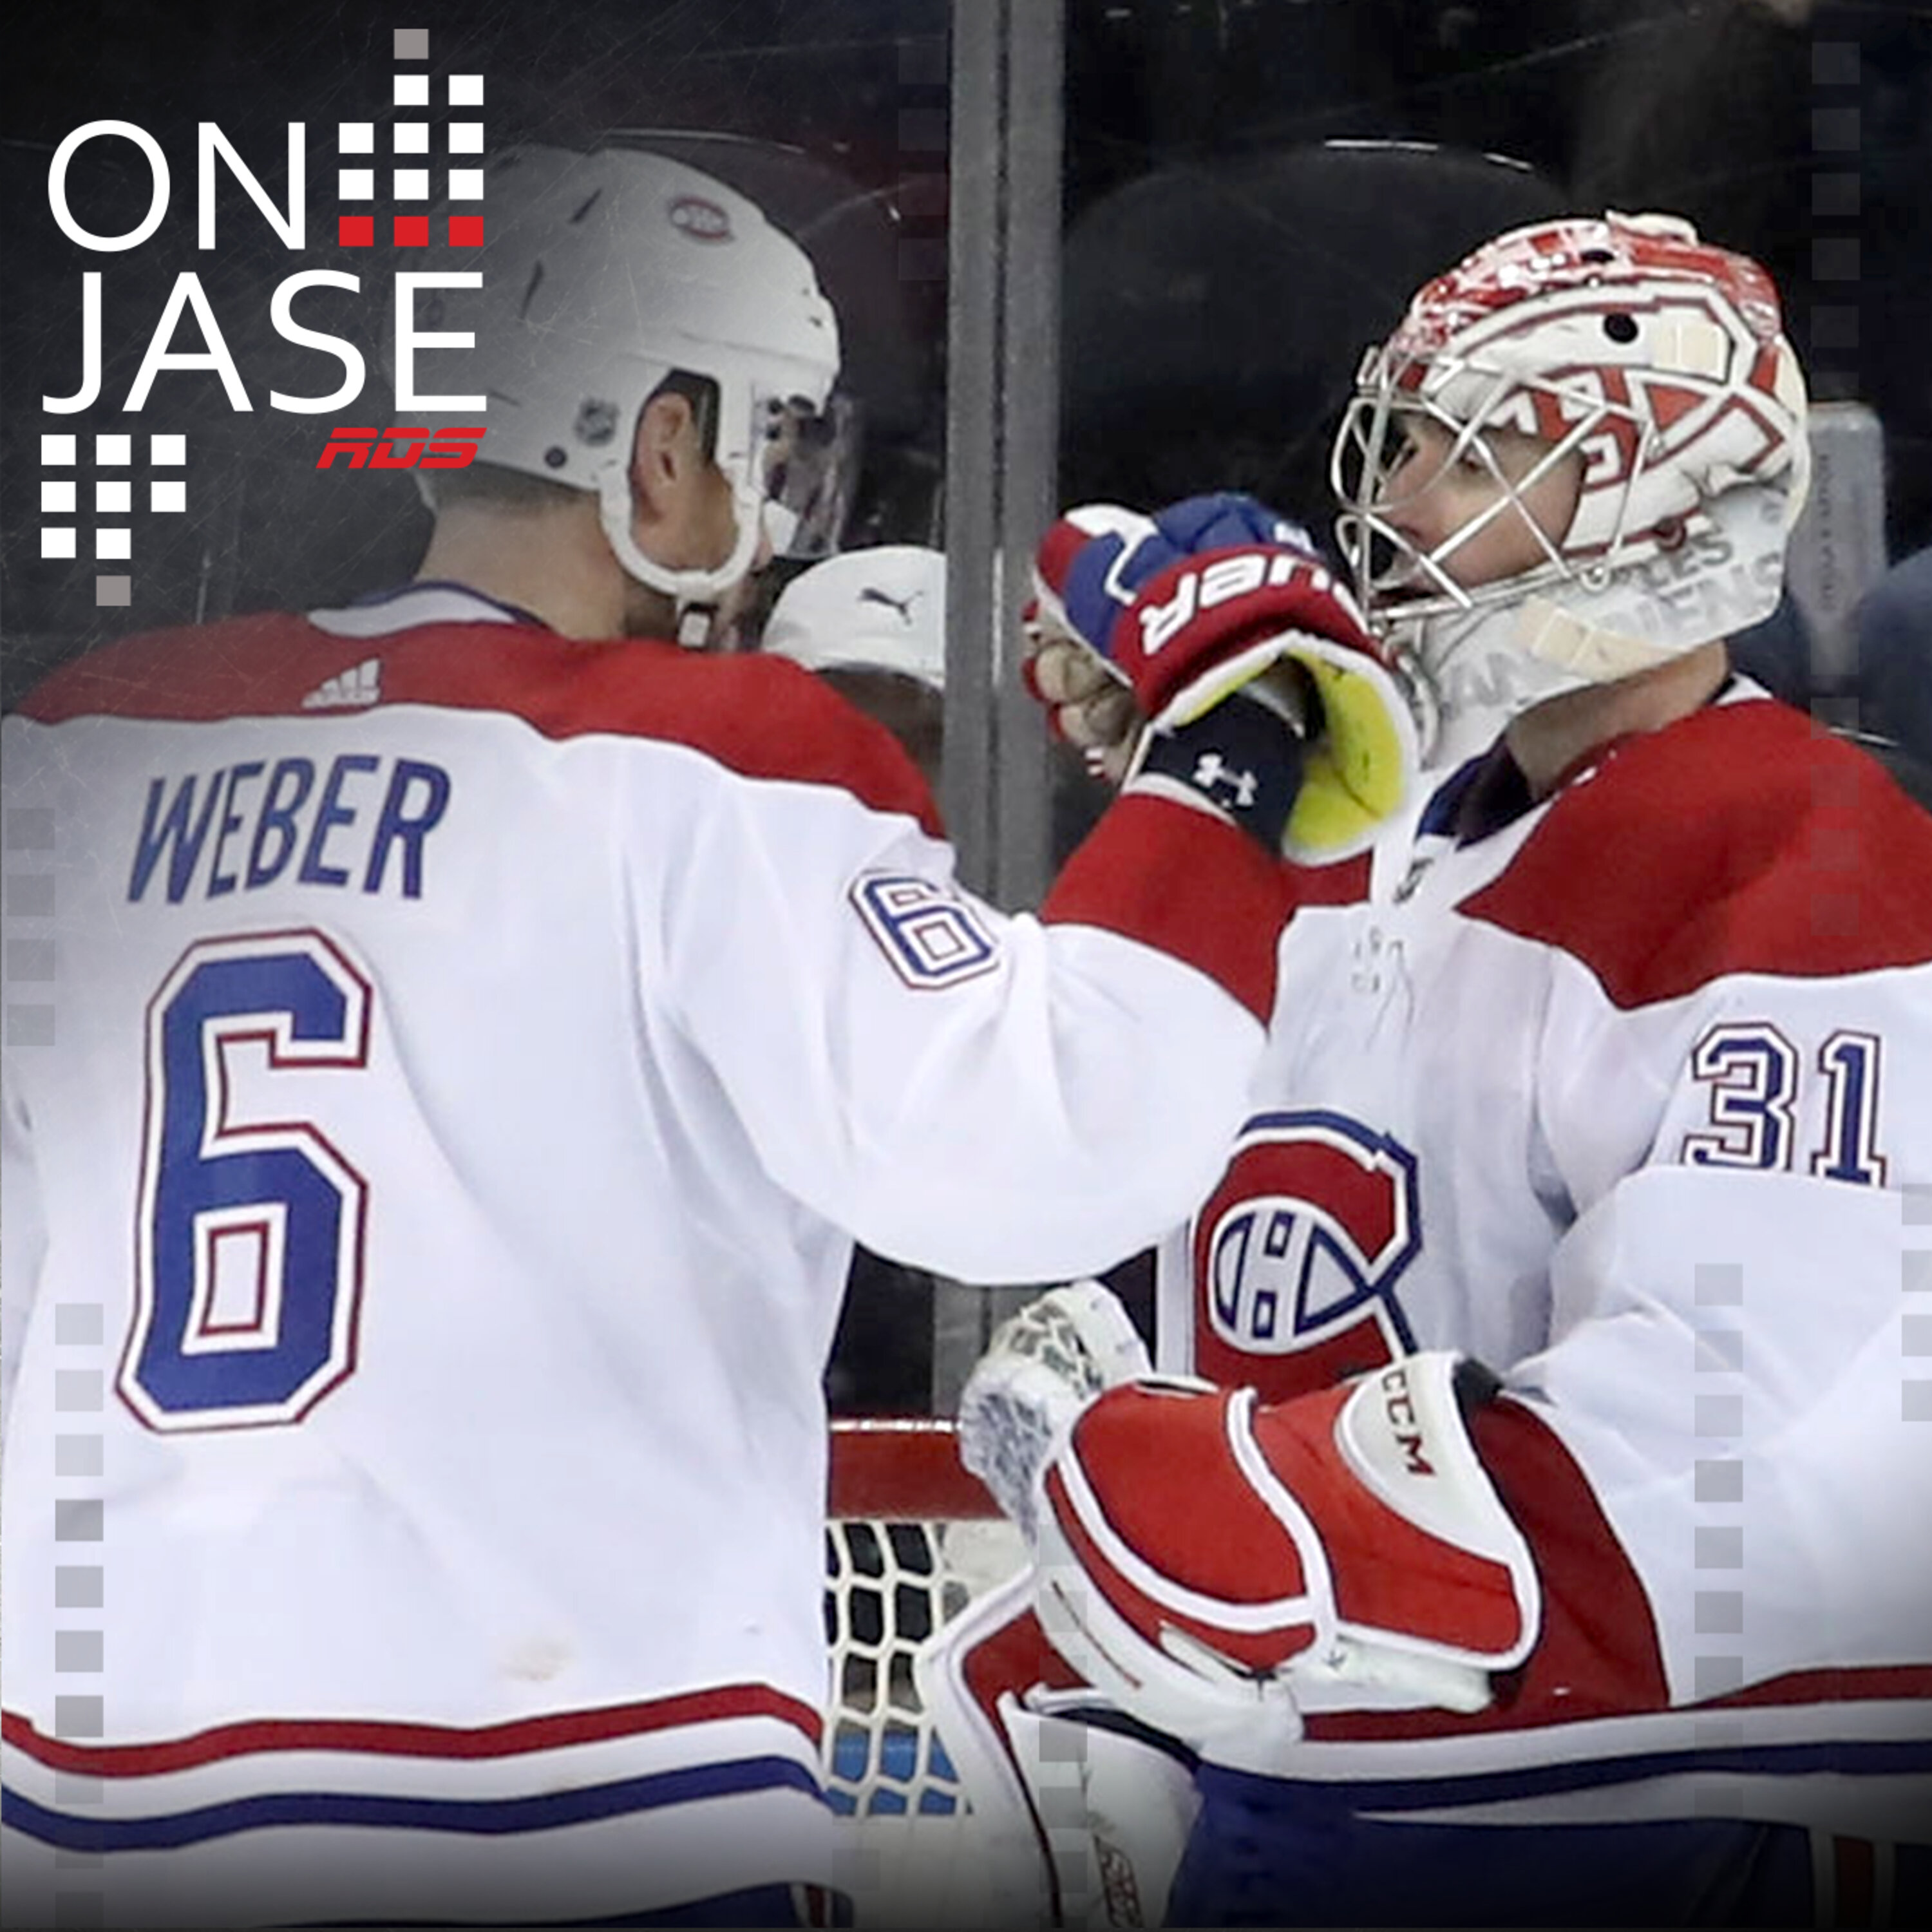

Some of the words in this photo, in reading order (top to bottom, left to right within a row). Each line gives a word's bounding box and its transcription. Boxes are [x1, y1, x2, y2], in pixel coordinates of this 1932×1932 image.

[128, 753, 451, 904] WEBER
[848, 868, 1001, 990] 6
[115, 927, 372, 1434] 6
[1680, 1022, 1887, 1188] 31
[1381, 1368, 1437, 1477] CCM
